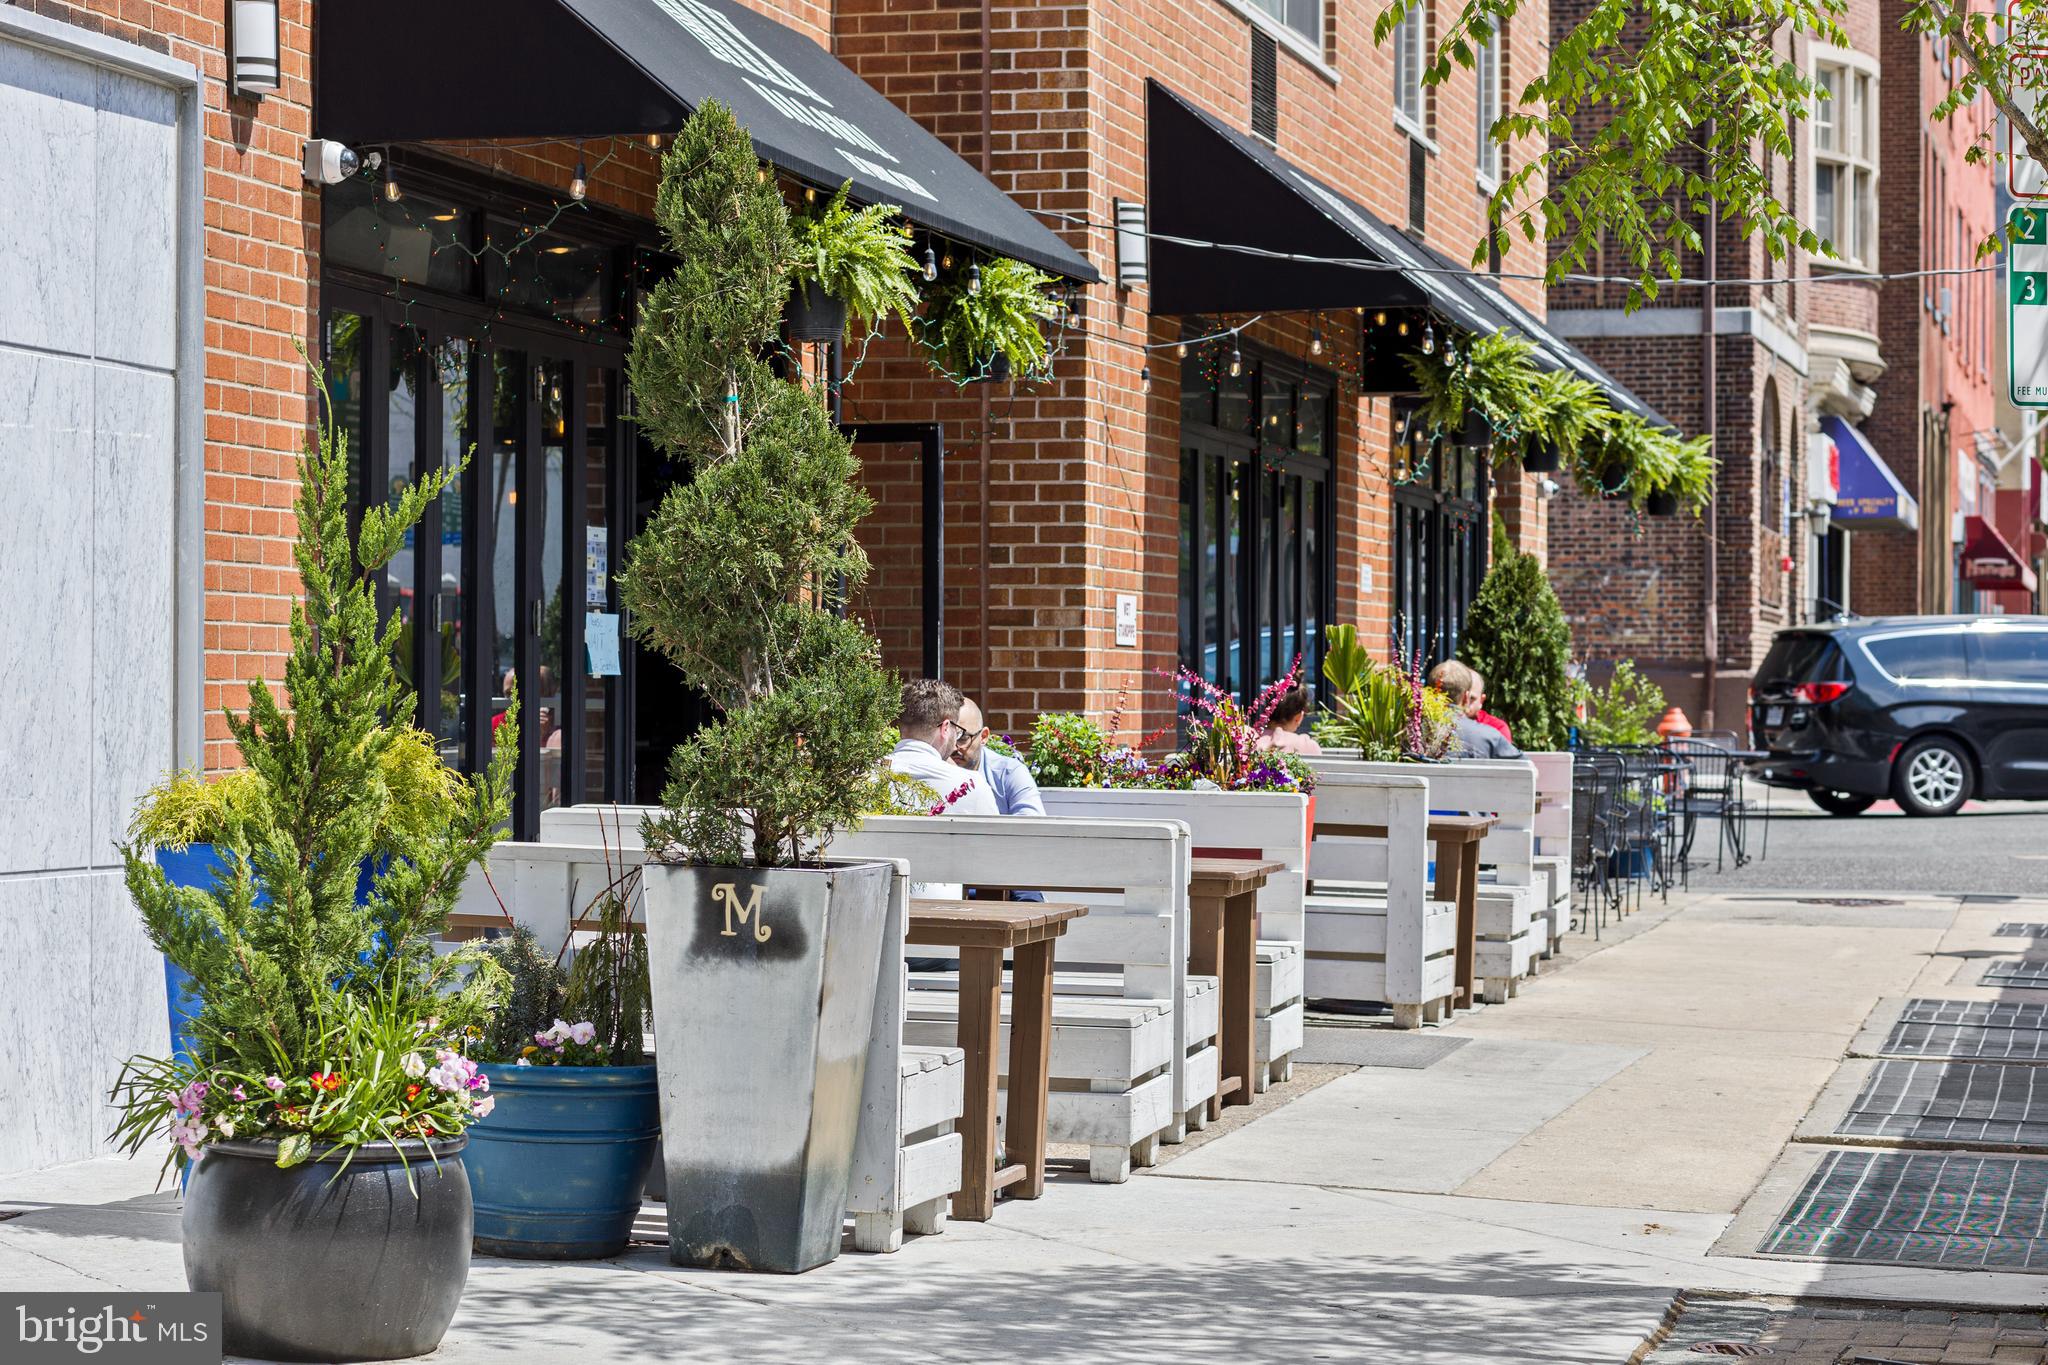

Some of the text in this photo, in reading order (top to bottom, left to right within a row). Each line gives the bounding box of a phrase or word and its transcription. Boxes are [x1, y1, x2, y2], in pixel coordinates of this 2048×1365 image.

[2023, 214, 2036, 240] 2
[2024, 275, 2036, 301] 3
[2017, 386, 2031, 396] FEE
[711, 882, 772, 943] M
